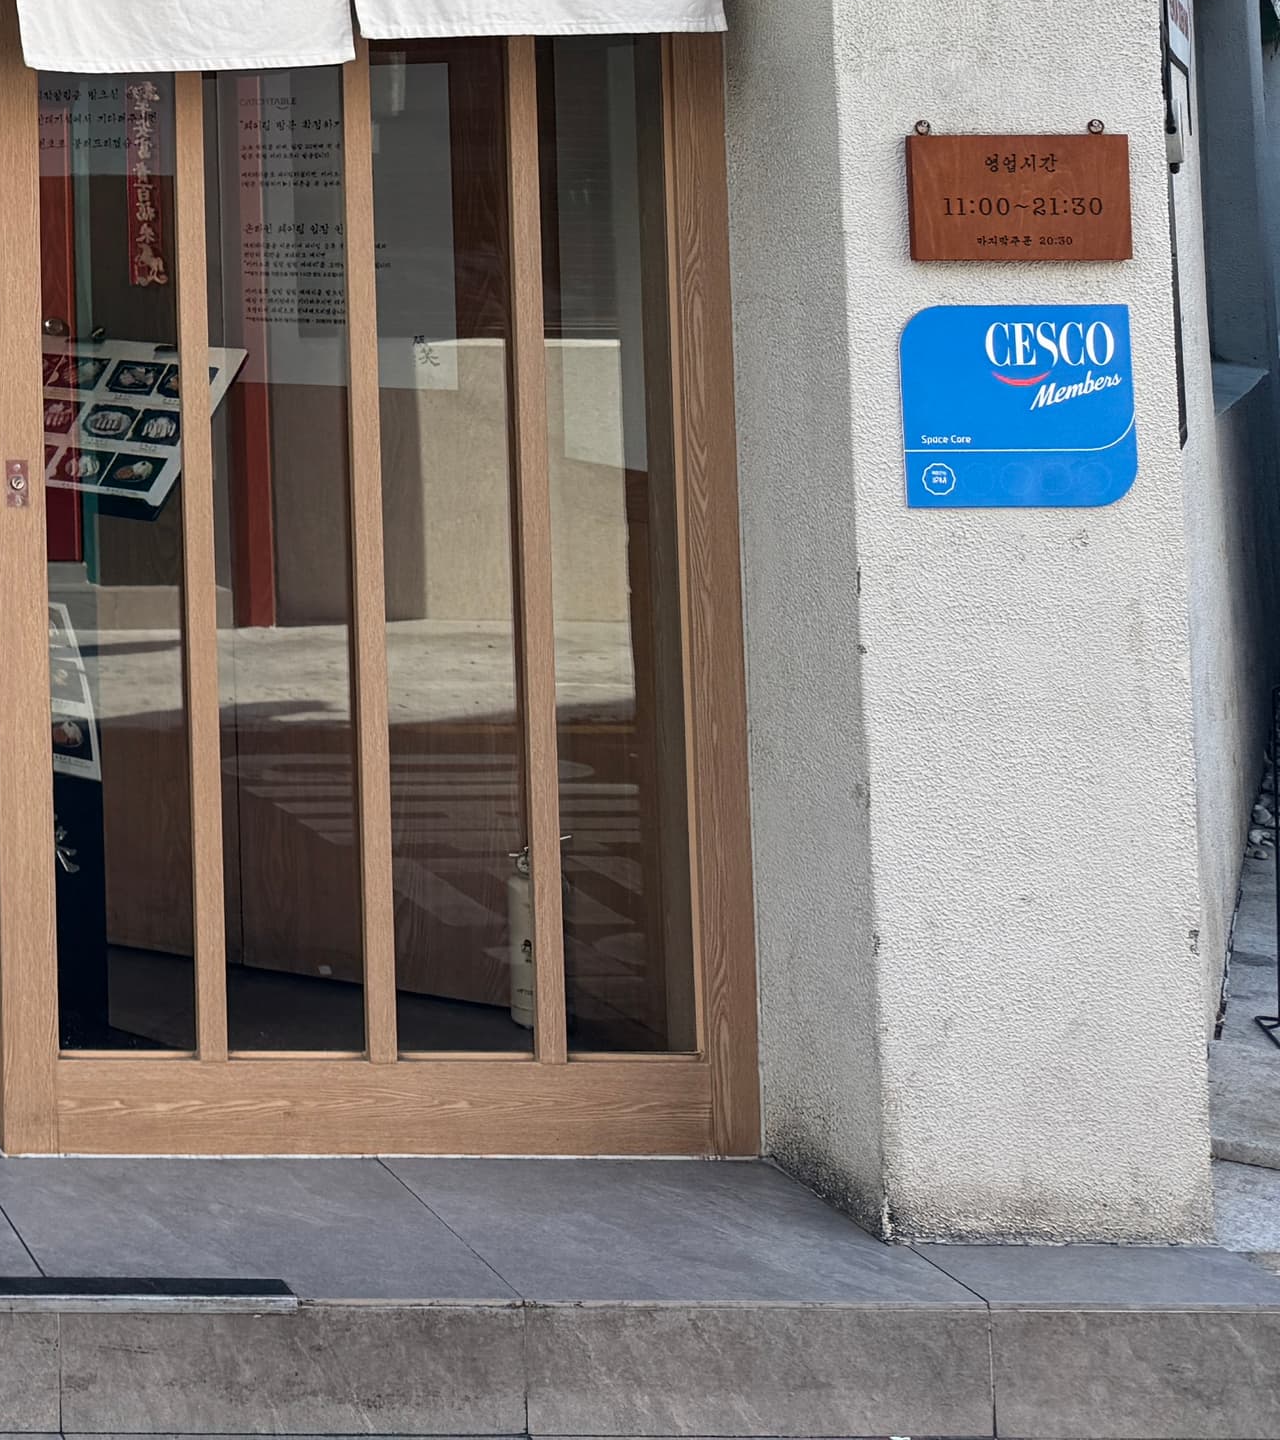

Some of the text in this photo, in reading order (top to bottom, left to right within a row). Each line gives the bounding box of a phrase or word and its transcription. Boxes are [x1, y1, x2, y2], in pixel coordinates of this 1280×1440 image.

[984, 153, 1058, 173] 영업시간
[942, 197, 1104, 216] 11:00~21:30
[1039, 235, 1074, 246] 20:30
[984, 321, 1115, 367] CESCO
[1029, 370, 1123, 411] Members
[921, 434, 972, 445] Space Care
